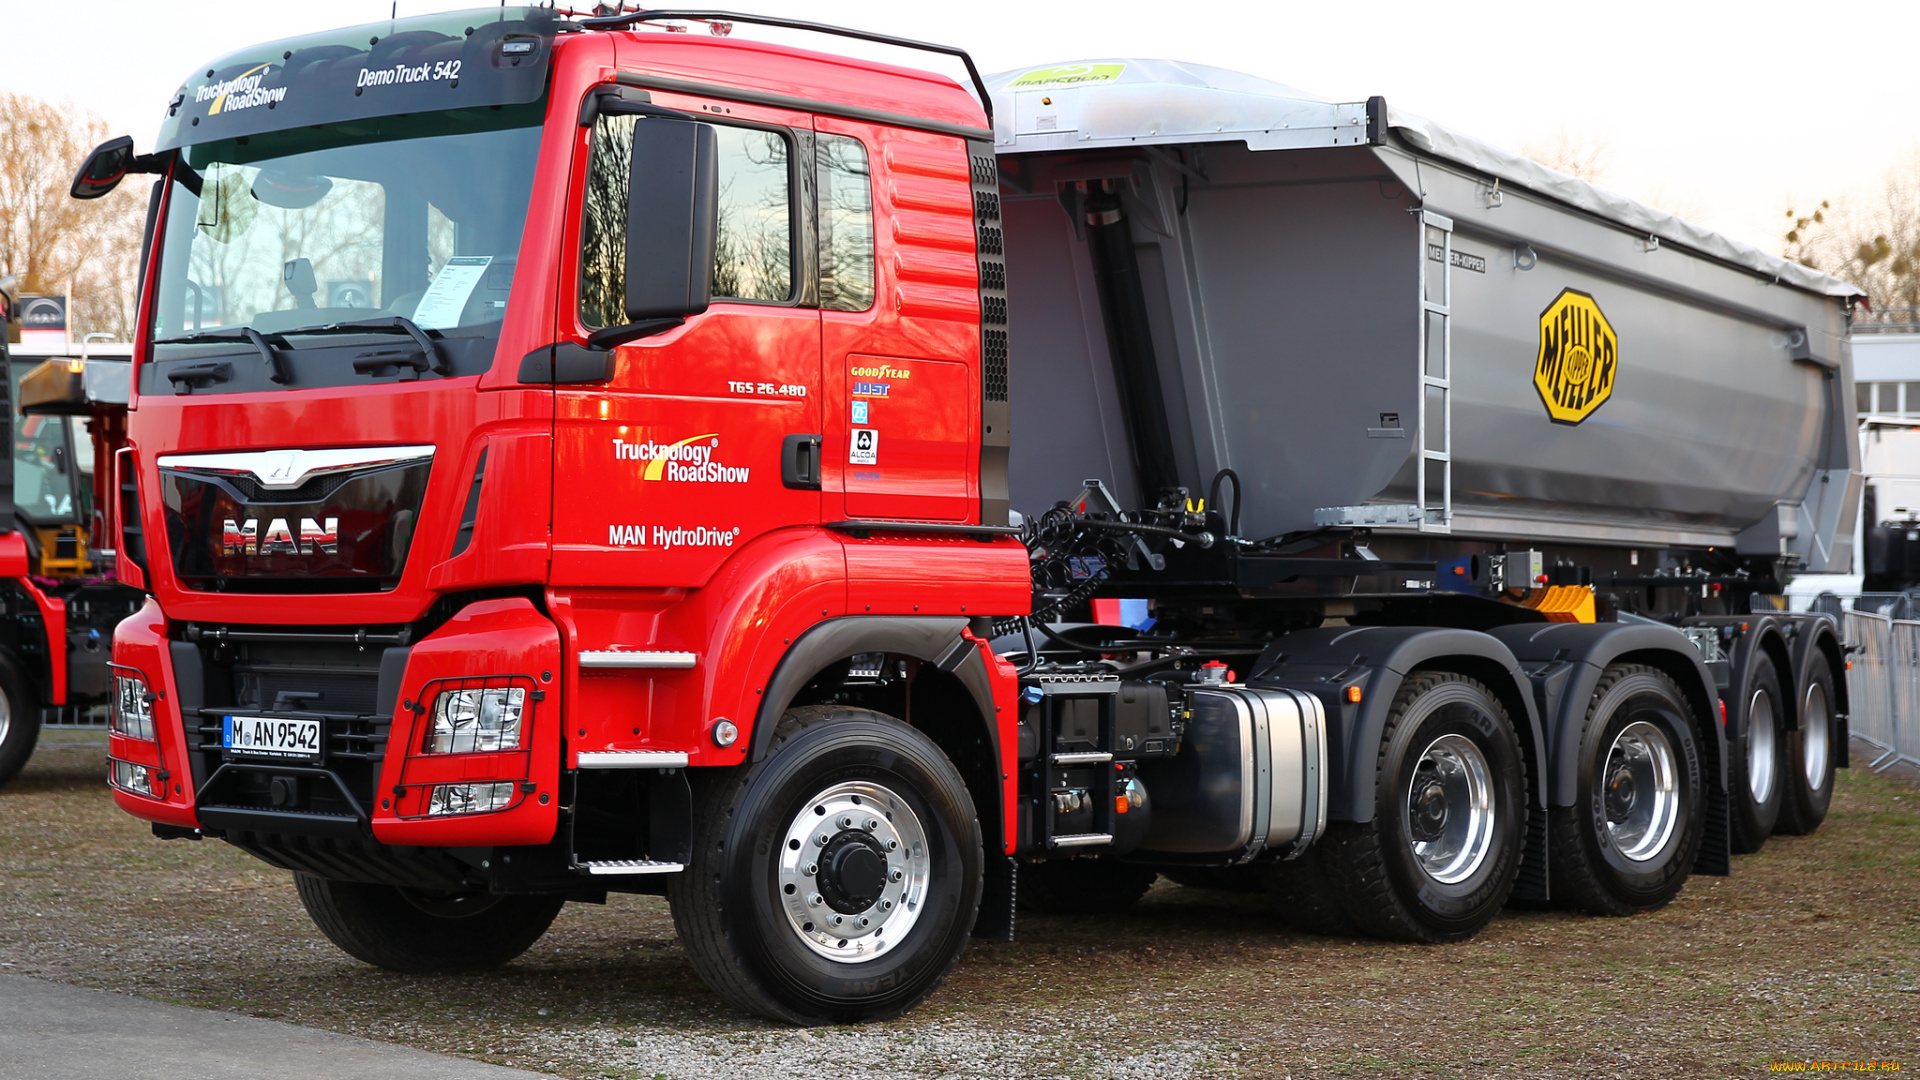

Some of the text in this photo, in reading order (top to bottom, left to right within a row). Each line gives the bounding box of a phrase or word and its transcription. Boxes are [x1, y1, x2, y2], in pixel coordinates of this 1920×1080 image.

[357, 60, 462, 87] DemoTruck 542
[224, 87, 287, 113] RoadShow
[1541, 303, 1614, 410] MEILLER
[851, 364, 910, 380] GOODYEAR
[727, 381, 806, 397] TGS 26.480
[852, 382, 891, 396] JOST
[851, 451, 876, 459] ALCOA
[667, 461, 749, 483] RoadShow
[223, 518, 338, 555] MAN
[609, 525, 646, 545] MAN
[233, 720, 317, 750] M AN 9542
